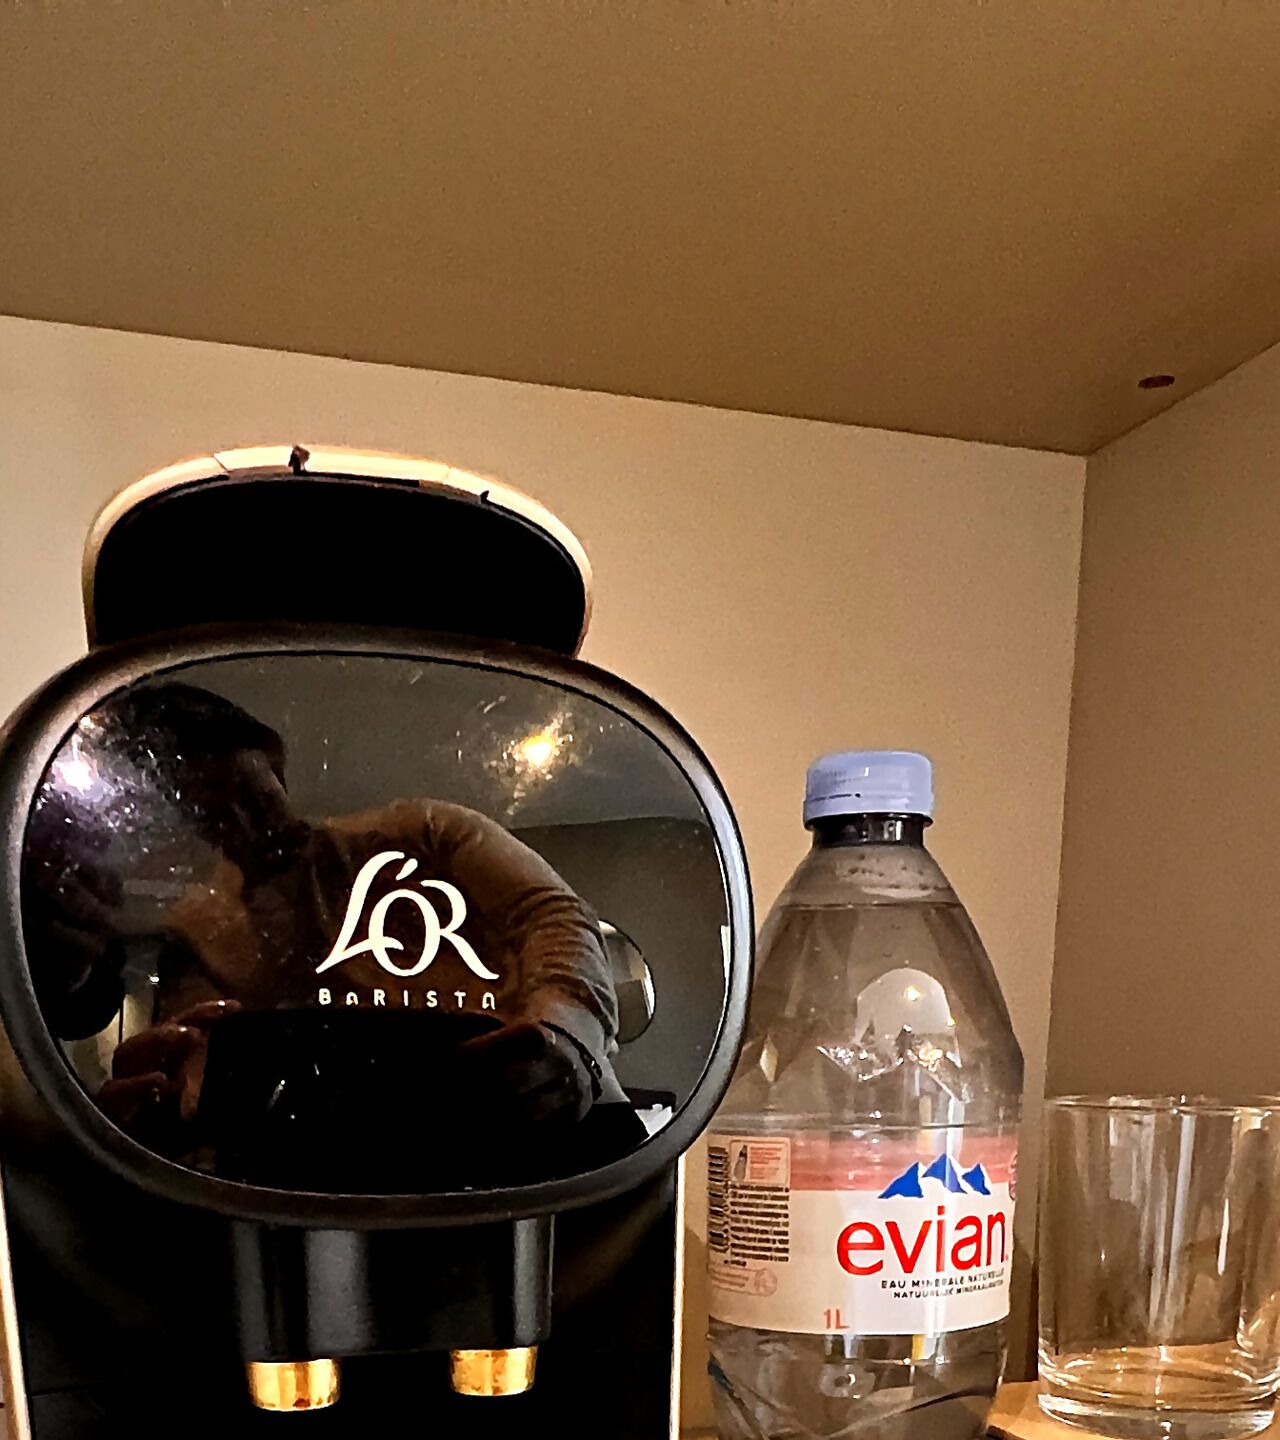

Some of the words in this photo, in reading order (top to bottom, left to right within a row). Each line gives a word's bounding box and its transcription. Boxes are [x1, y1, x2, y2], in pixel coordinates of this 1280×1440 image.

[318, 987, 496, 1010] BARISTA
[836, 1205, 1006, 1276] evian
[881, 1279, 907, 1289] EAU
